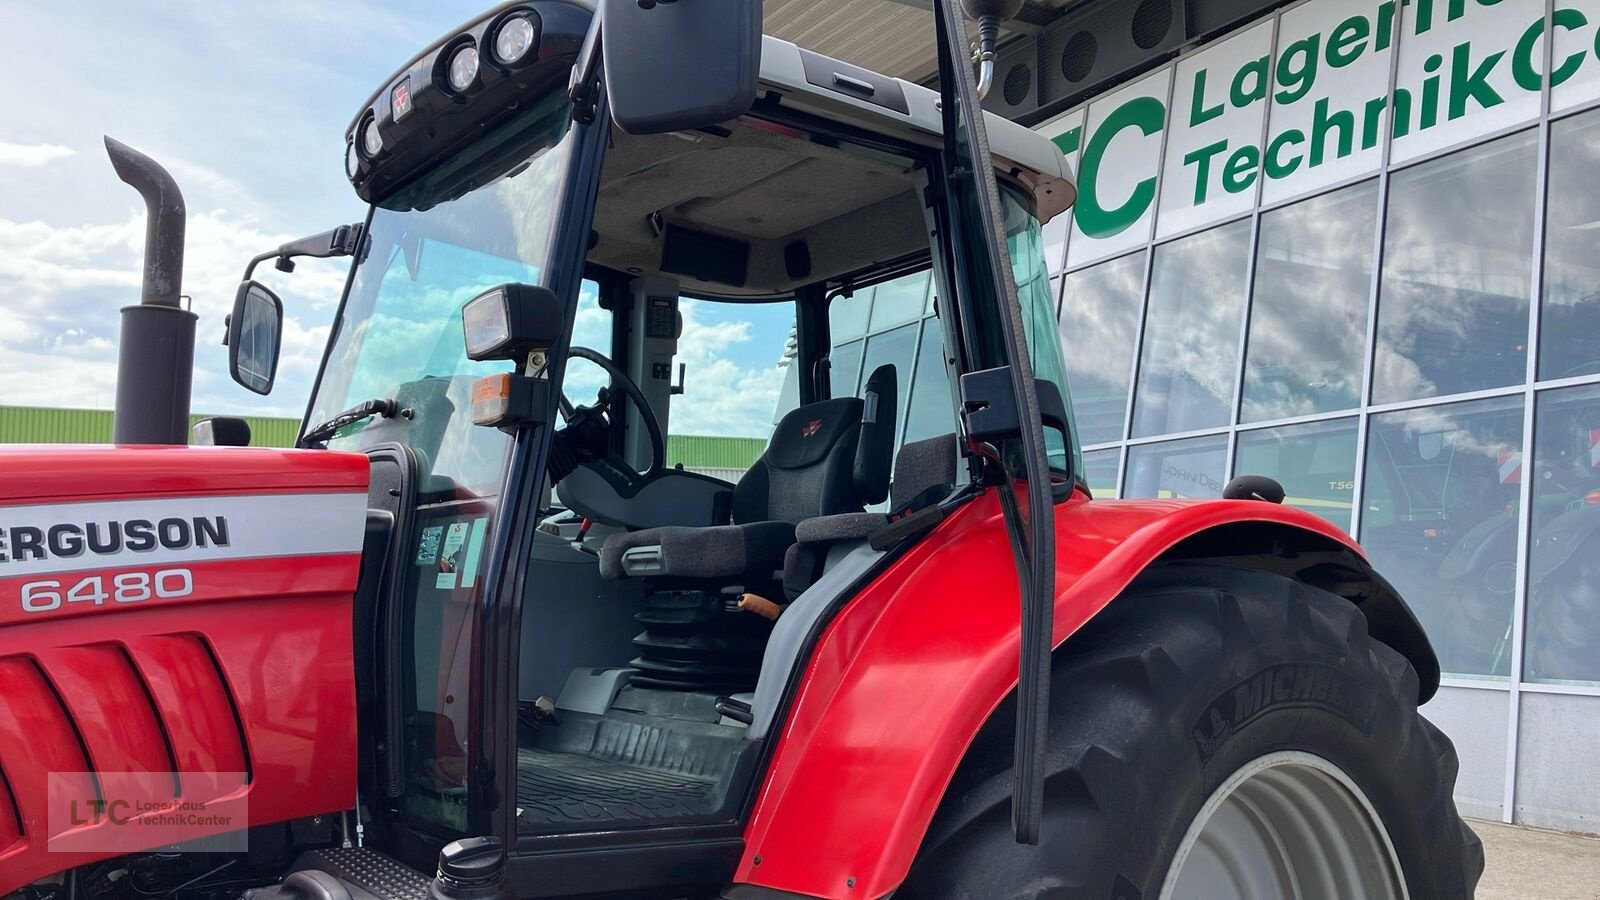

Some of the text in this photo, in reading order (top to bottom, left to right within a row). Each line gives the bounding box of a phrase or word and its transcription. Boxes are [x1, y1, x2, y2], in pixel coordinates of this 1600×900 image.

[1182, 8, 1600, 207] TechnikC
[0, 515, 231, 563] RGUSON
[20, 567, 194, 613] 6480
